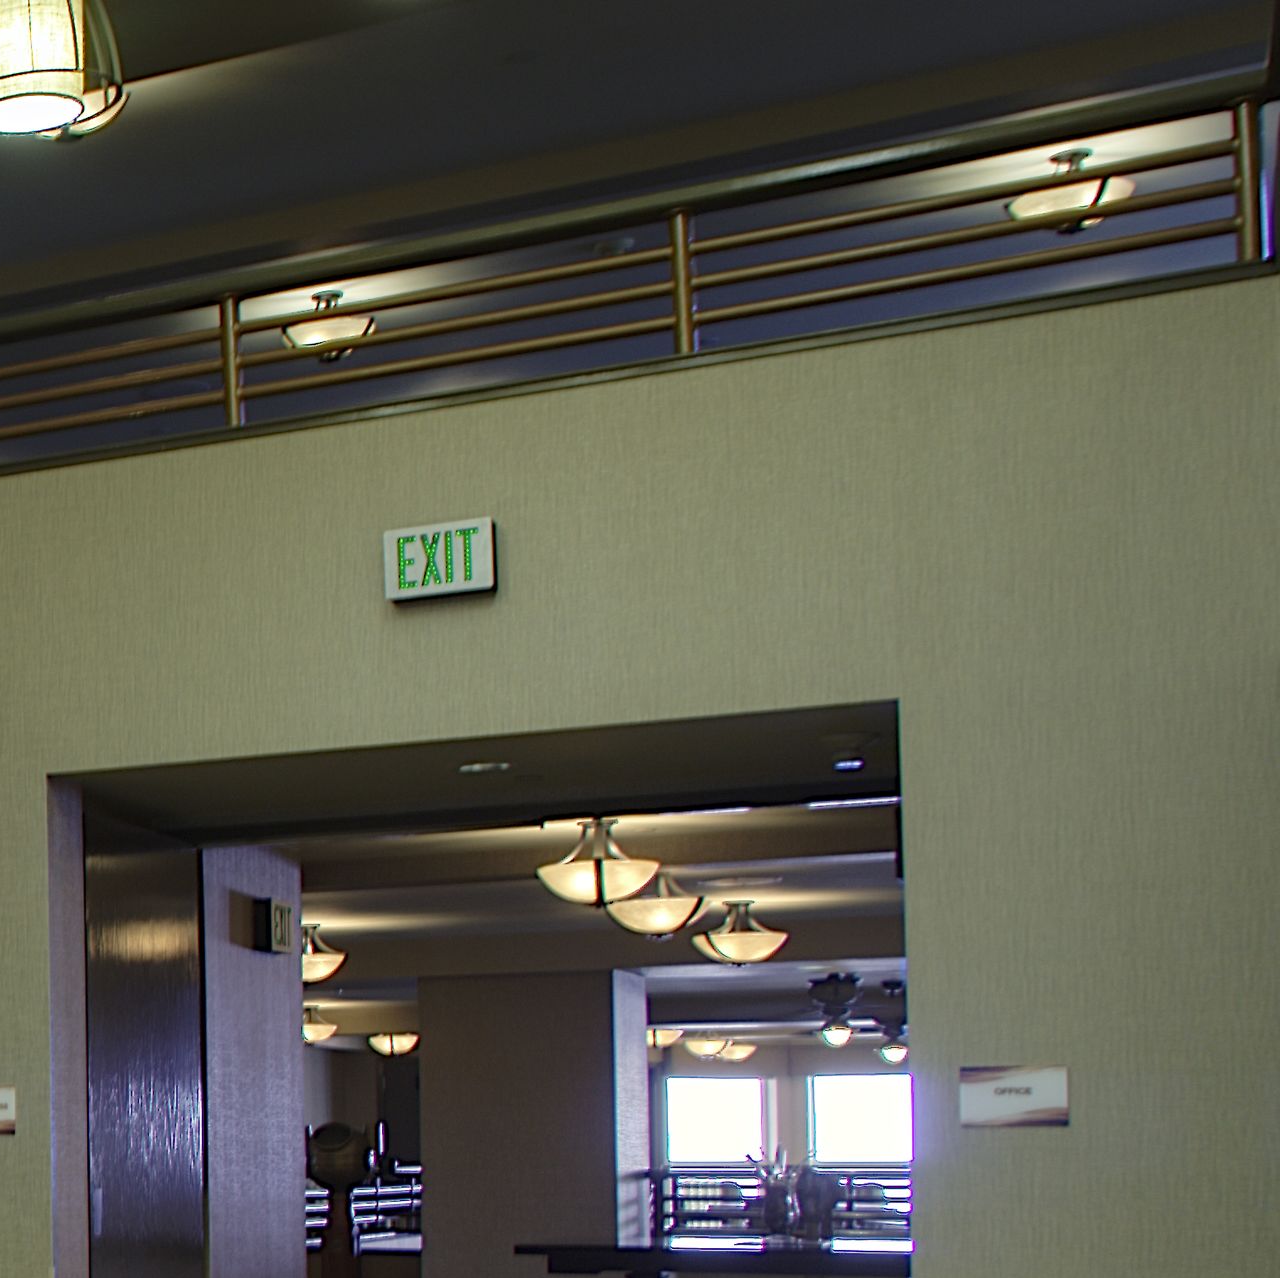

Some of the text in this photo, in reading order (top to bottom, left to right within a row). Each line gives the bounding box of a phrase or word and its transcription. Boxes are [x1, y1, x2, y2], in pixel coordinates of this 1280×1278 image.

[397, 527, 479, 589] EXIT
[273, 904, 292, 946] EXIT
[993, 1086, 1033, 1096] OFFICE
